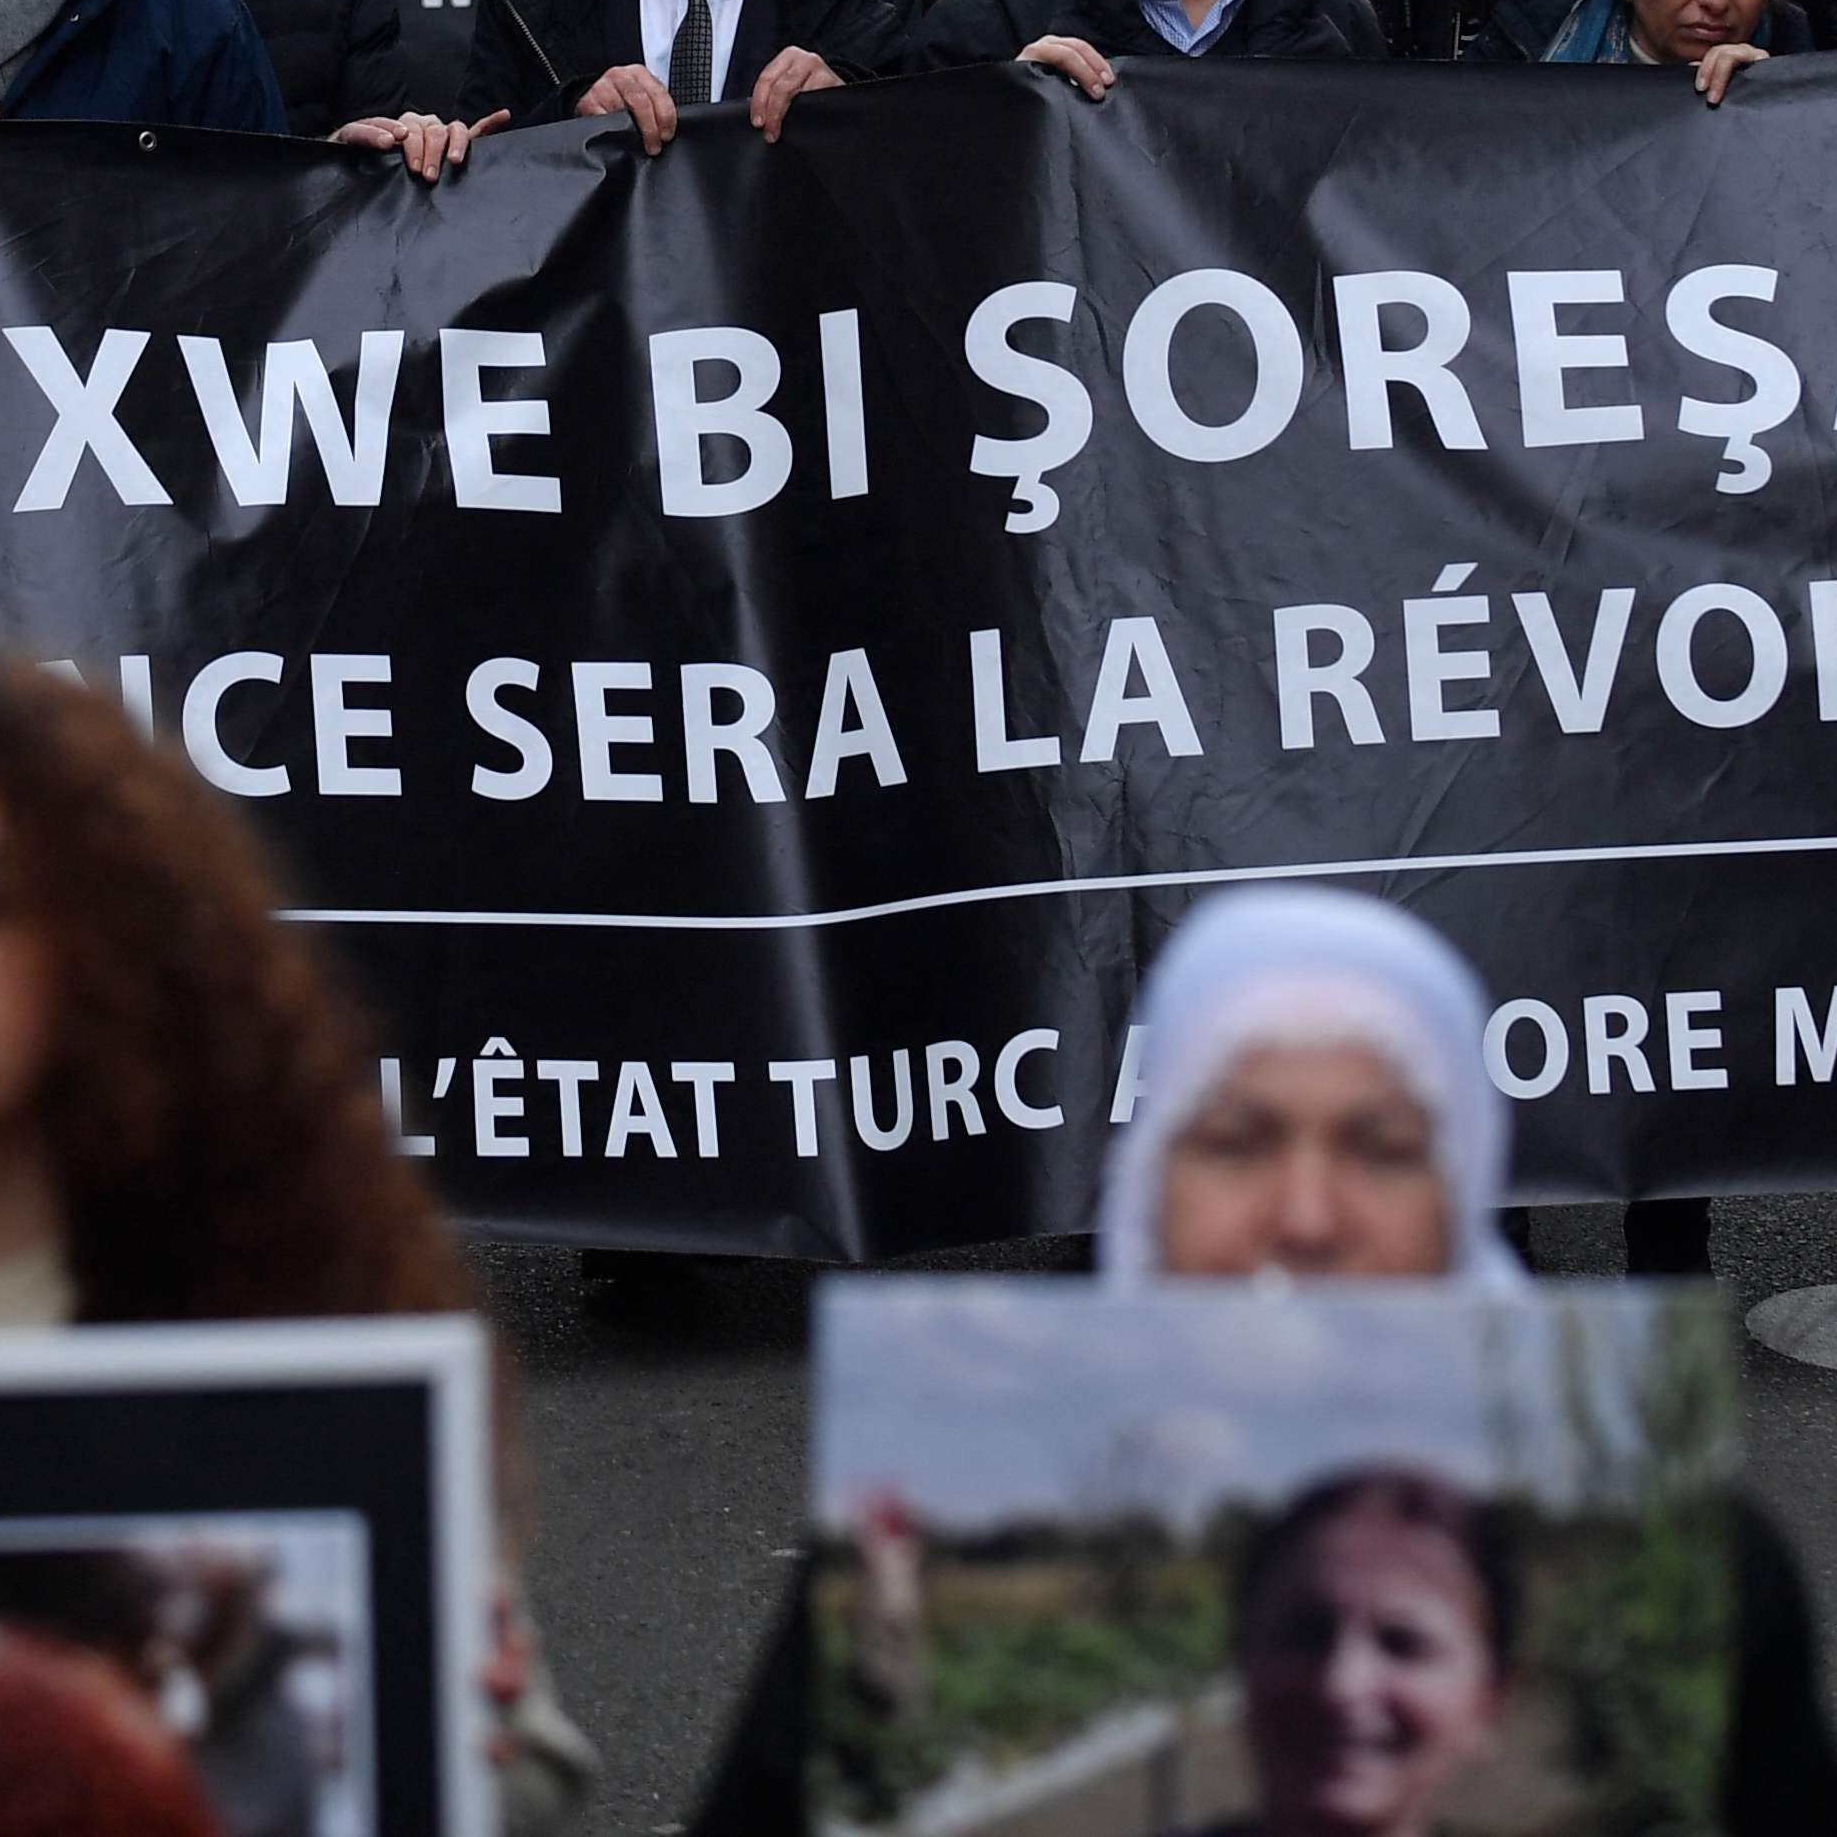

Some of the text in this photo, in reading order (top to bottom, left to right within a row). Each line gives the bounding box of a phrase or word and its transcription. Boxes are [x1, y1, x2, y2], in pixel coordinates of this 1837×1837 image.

[1, 324, 563, 514] XWE
[647, 307, 870, 519] BI
[464, 647, 908, 805] SERA
[969, 615, 1205, 774] LA
[767, 1027, 1066, 1160] TURC
